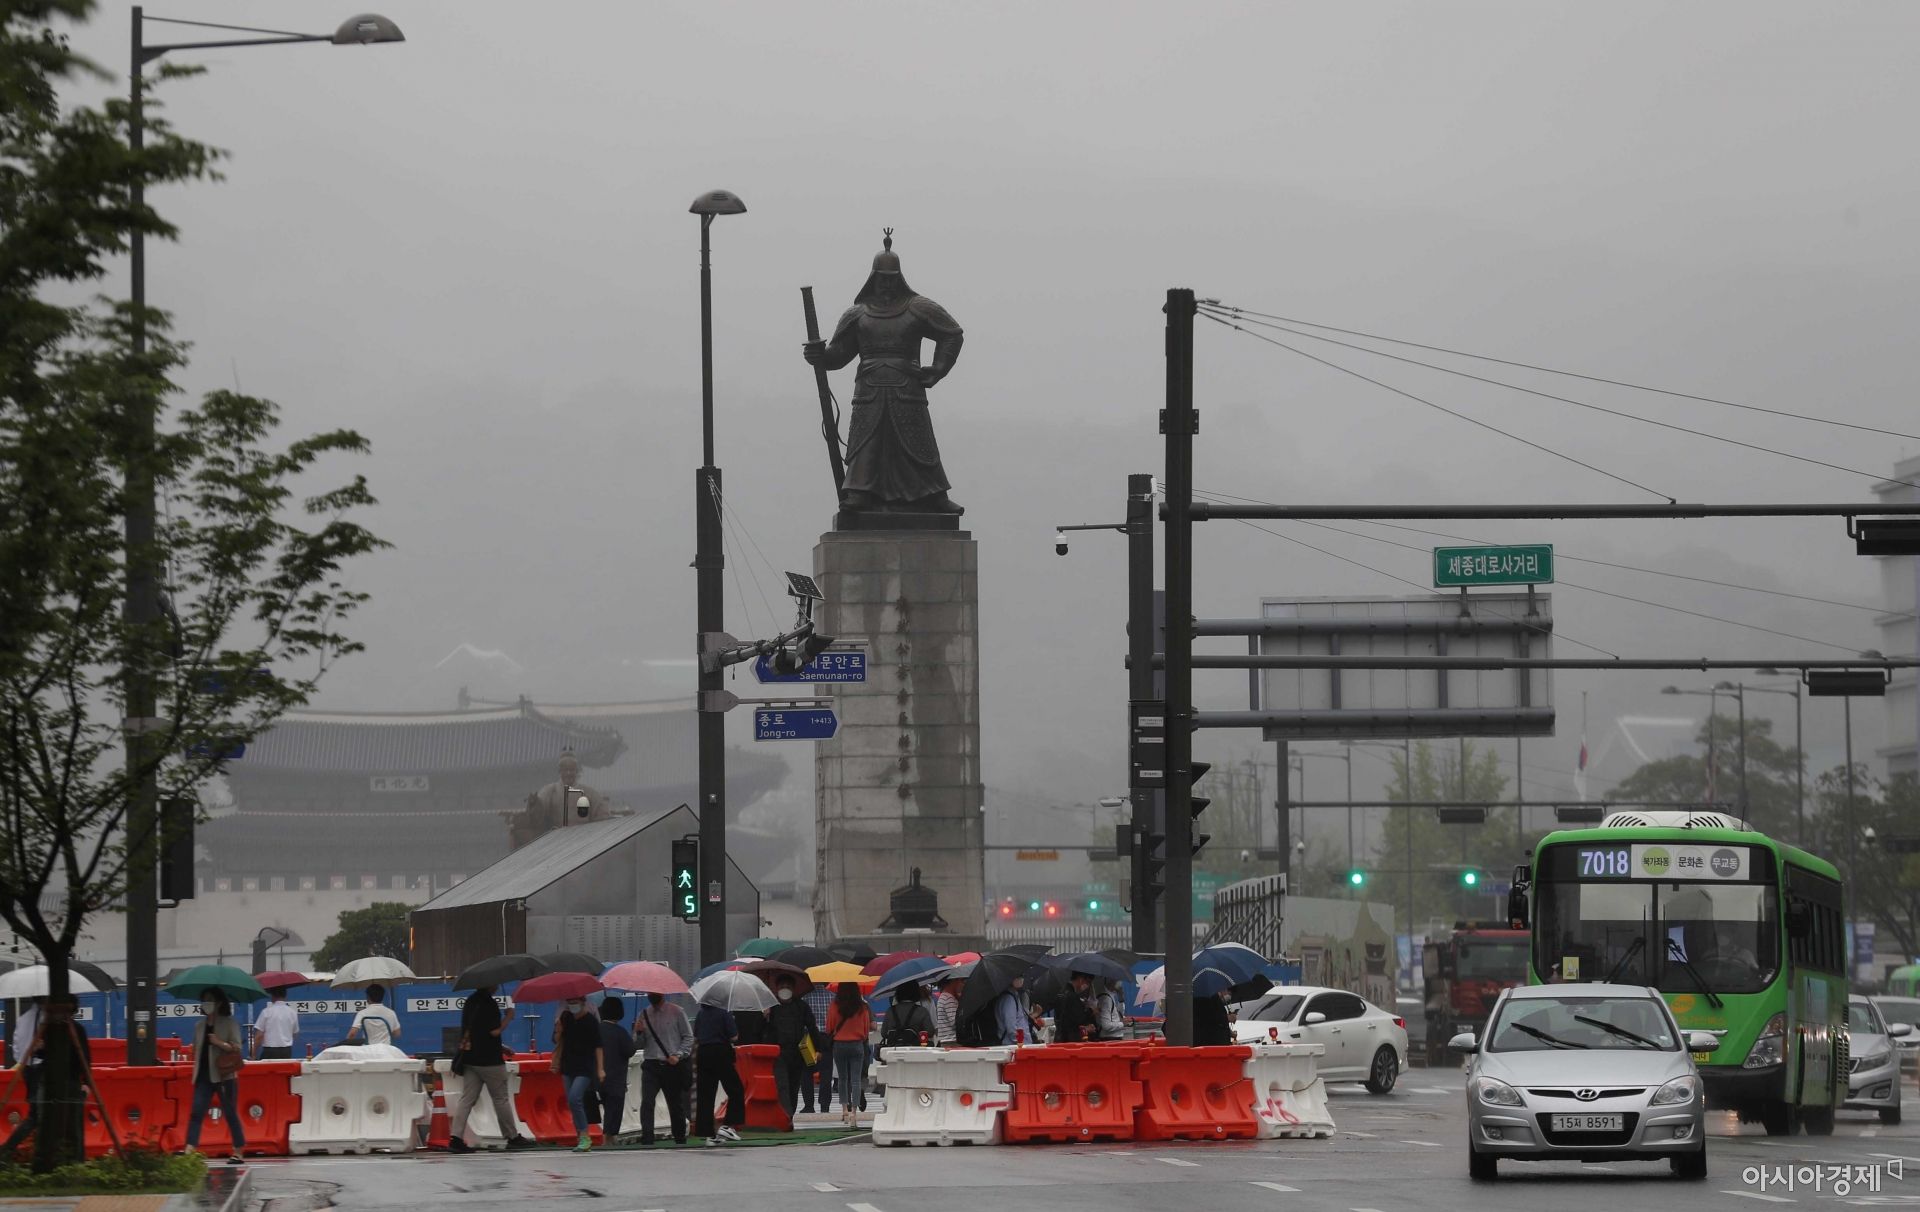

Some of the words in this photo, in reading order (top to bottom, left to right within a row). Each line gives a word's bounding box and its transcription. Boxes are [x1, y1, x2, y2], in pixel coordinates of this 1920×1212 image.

[1448, 553, 1538, 577] 세종대로사거리
[799, 671, 863, 680] Saemunan-ro
[758, 713, 786, 727] 종로
[758, 729, 796, 739] Jong-ro
[1581, 851, 1629, 875] 7018
[1678, 857, 1704, 868] 문화촌
[1712, 857, 1738, 870] 무교동
[685, 895, 695, 913] 5
[1587, 1117, 1615, 1128] 8591
